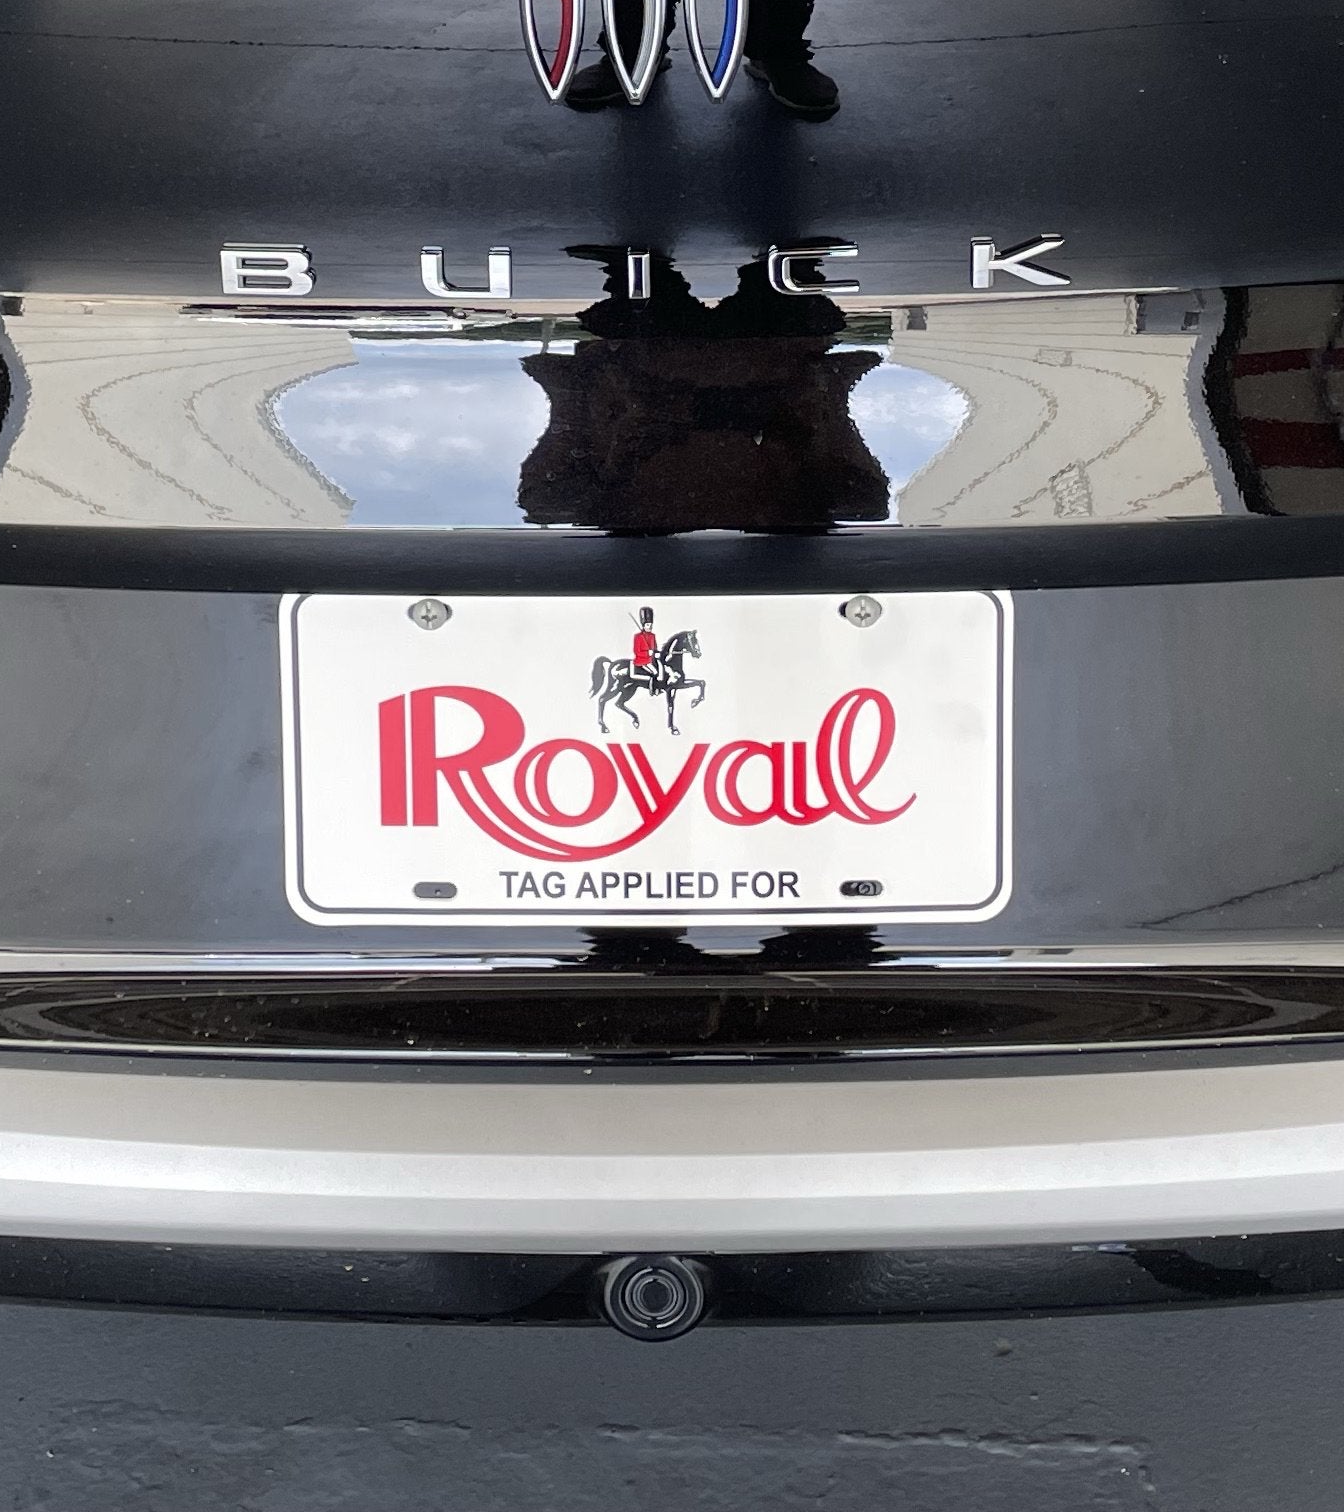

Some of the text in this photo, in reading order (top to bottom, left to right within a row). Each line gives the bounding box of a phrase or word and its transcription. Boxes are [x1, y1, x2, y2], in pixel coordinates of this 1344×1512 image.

[219, 232, 1072, 301] BUICK
[378, 684, 918, 863] Royal
[498, 870, 801, 900] TAG APPLIED FOR
